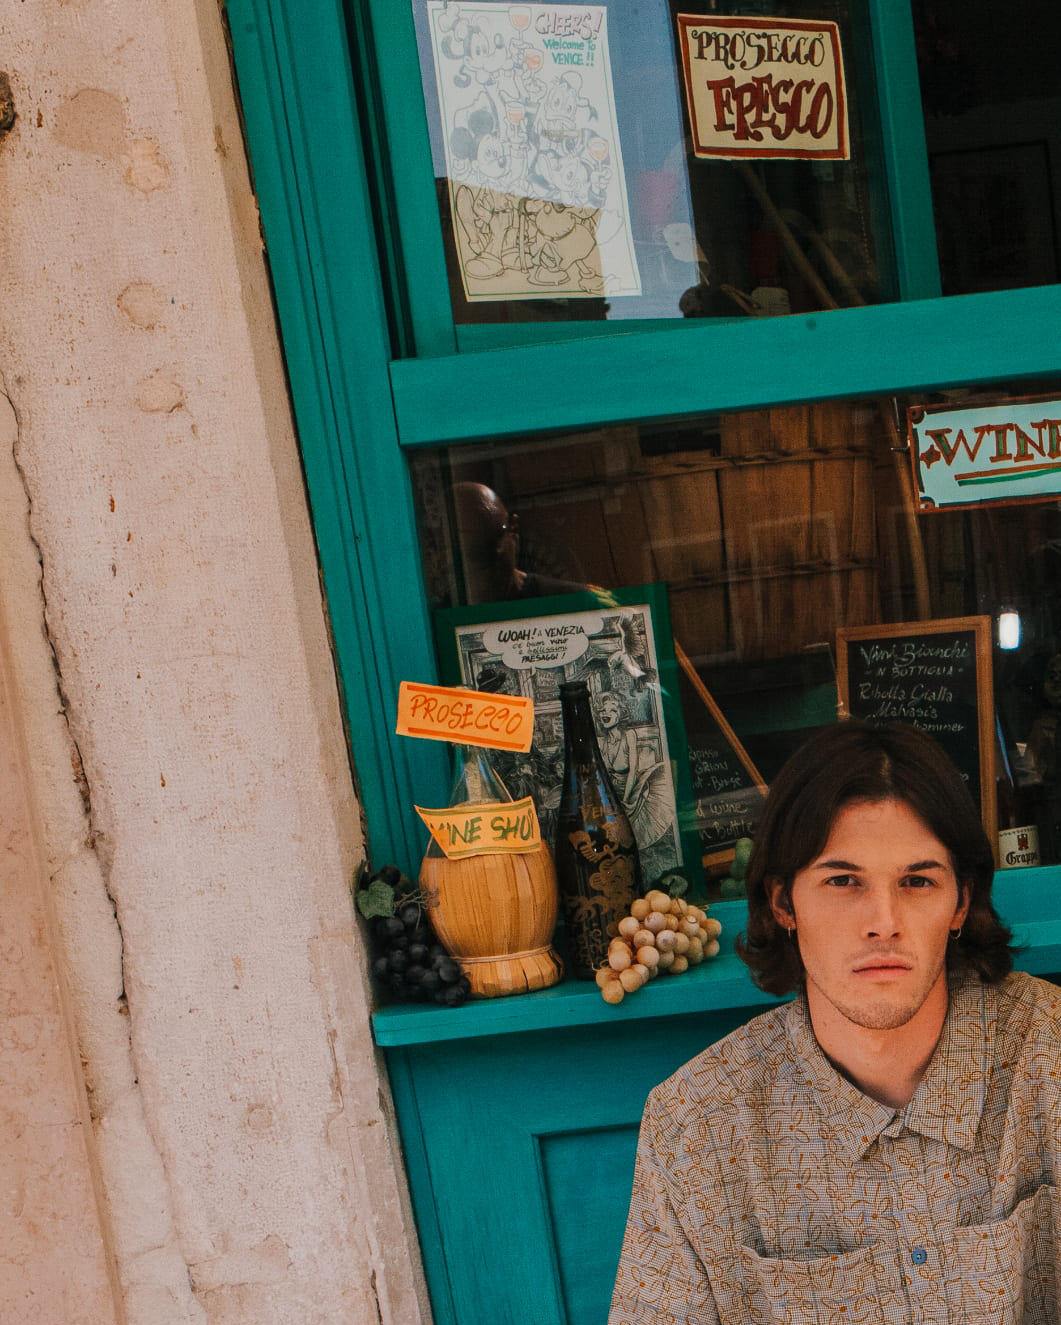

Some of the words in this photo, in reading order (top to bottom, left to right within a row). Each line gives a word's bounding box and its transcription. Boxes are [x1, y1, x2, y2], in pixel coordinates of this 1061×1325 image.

[535, 11, 603, 40] CHEERS!
[542, 37, 585, 50] Welcome
[691, 30, 825, 70] PROSECCO
[706, 73, 834, 141] FRESCO
[497, 627, 538, 643] WOAH!
[544, 624, 586, 638] VENEZIA
[409, 694, 523, 734] PROSECCO
